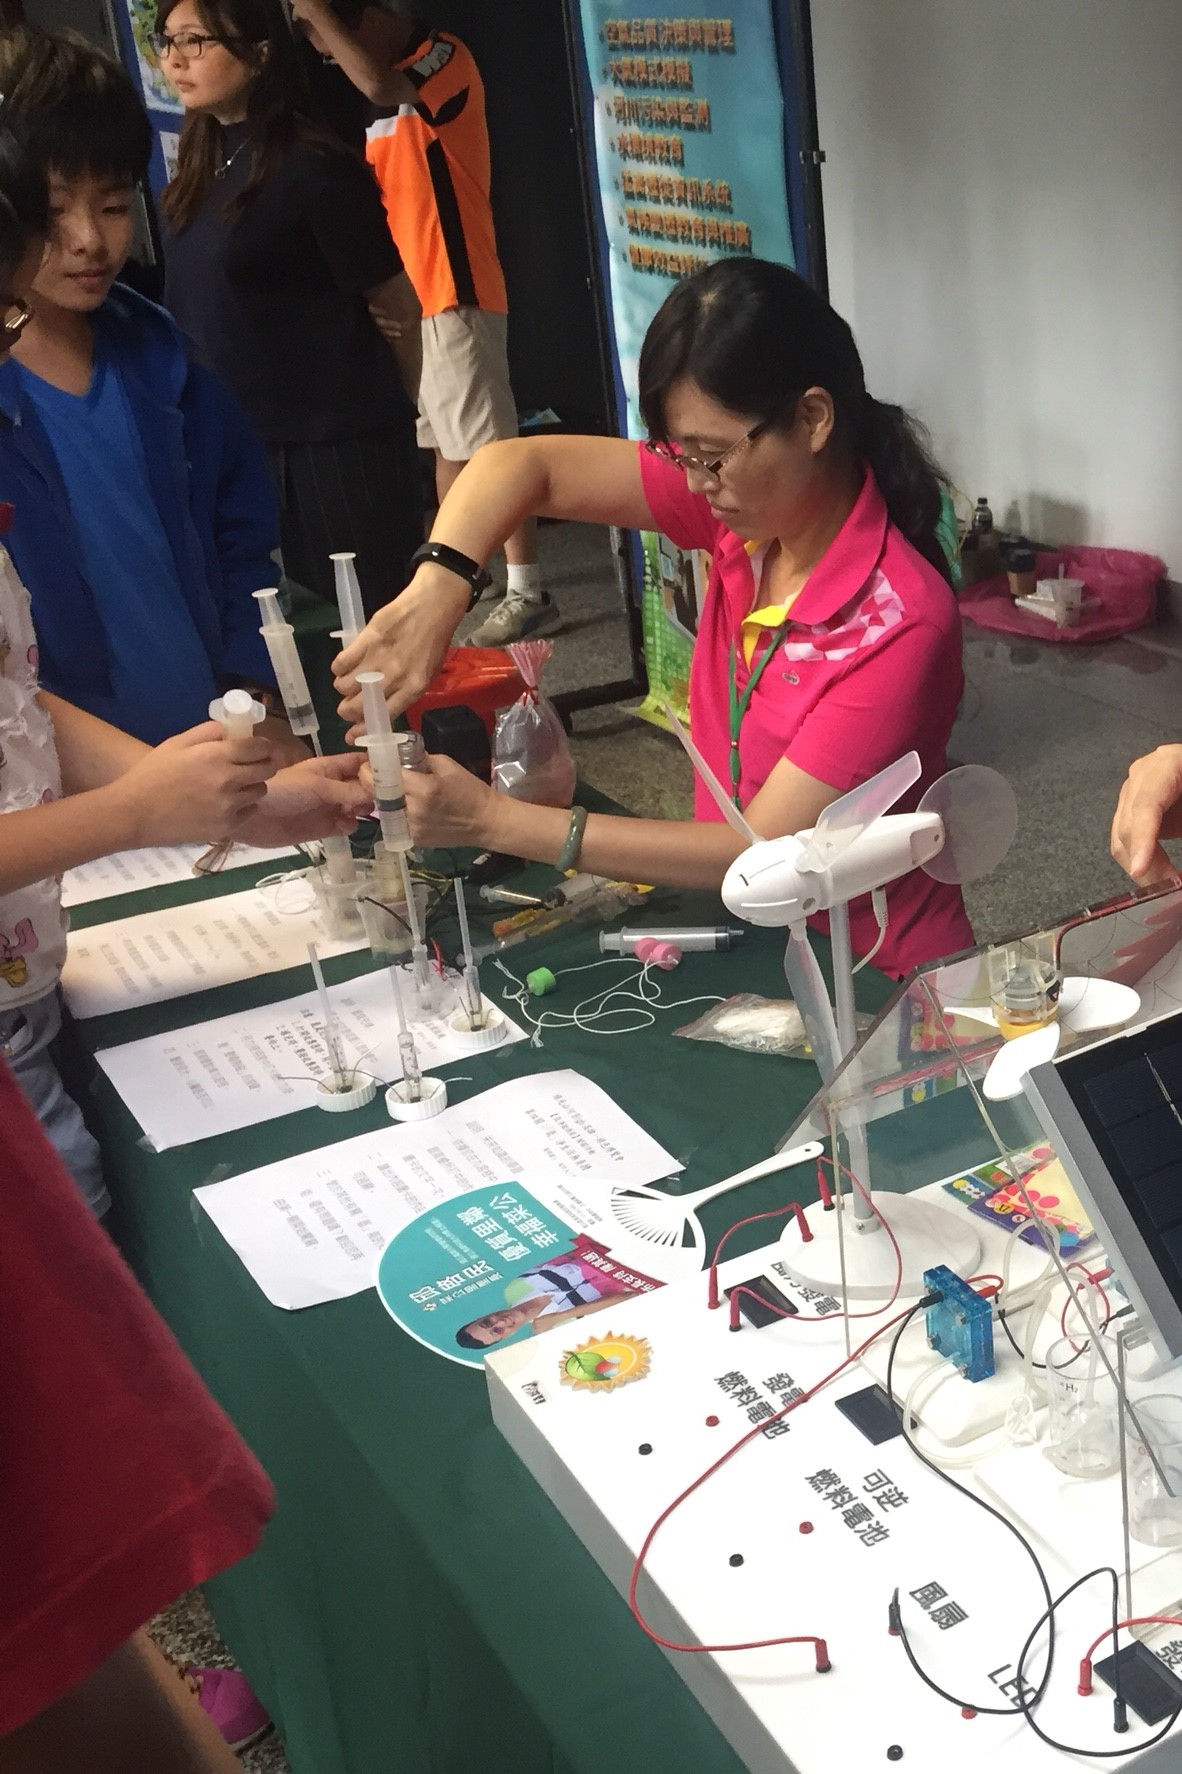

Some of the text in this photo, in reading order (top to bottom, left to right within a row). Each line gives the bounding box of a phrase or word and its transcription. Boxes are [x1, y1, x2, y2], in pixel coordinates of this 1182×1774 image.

[456, 1205, 532, 1262] 優質里鄰
[489, 1192, 561, 1249] 幸福菜公
[714, 1371, 790, 1440] 燃料電池
[762, 1372, 811, 1409] 發電
[804, 1468, 890, 1547] 燃料電池
[862, 1468, 910, 1513] 可逆
[909, 1581, 970, 1630] 風扇
[987, 1664, 1040, 1708] LED
